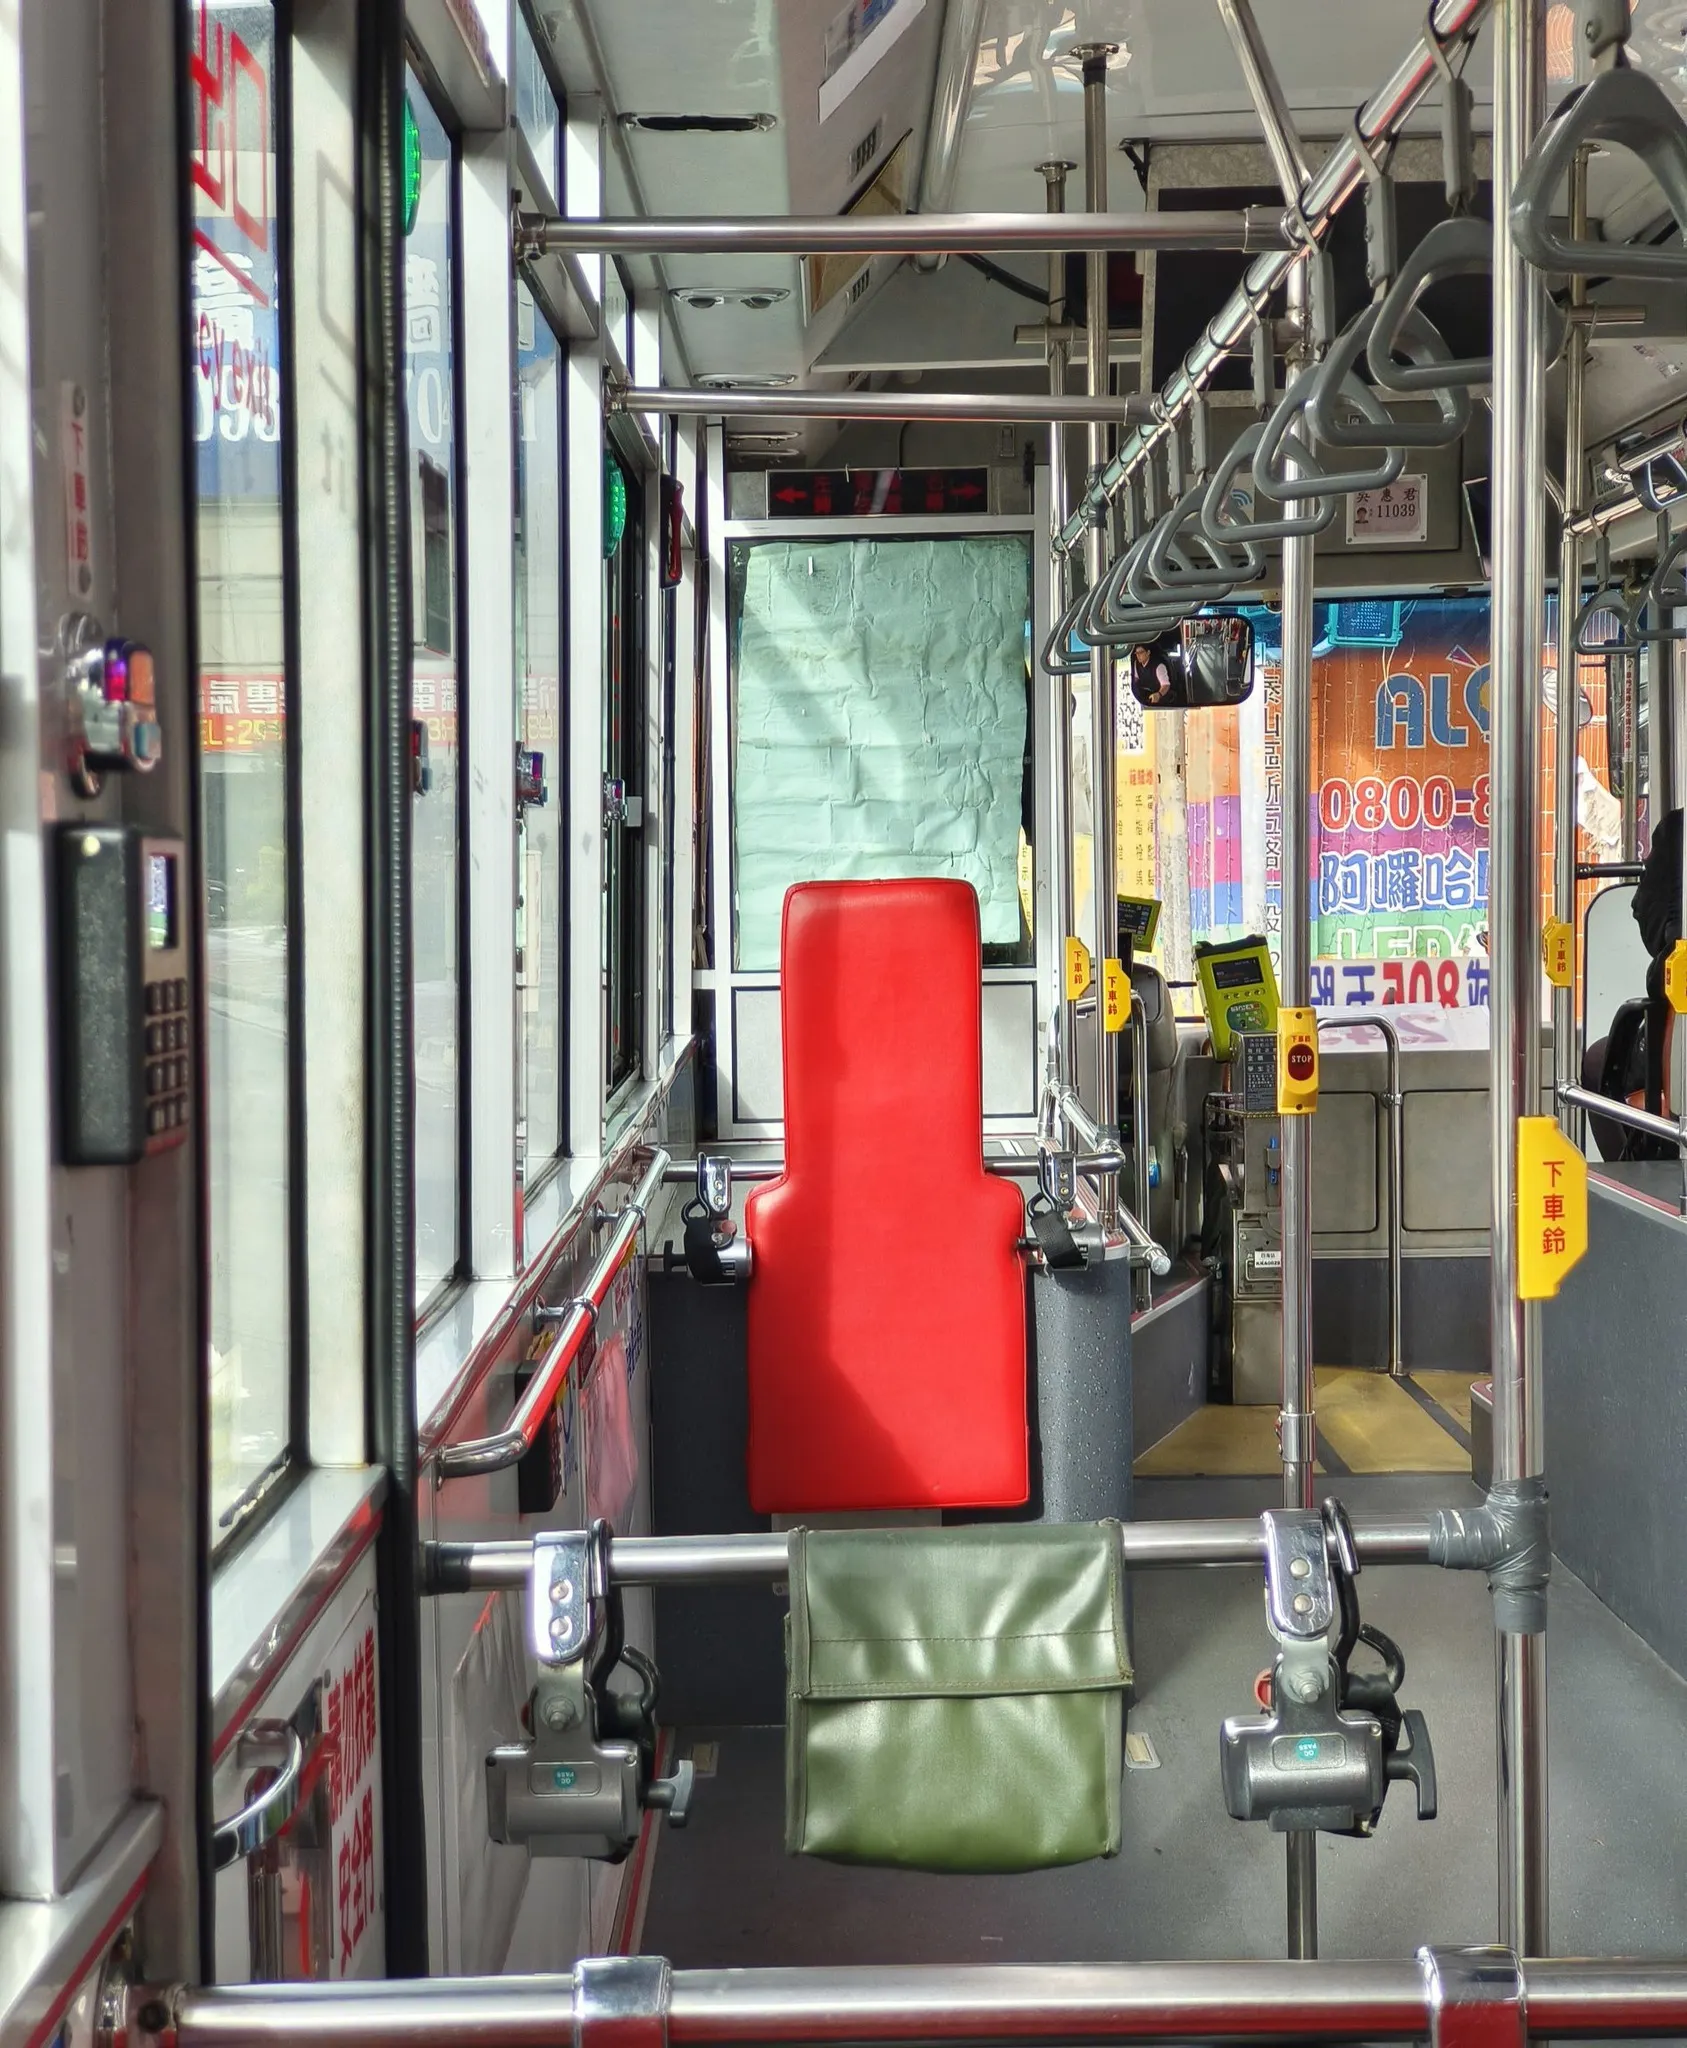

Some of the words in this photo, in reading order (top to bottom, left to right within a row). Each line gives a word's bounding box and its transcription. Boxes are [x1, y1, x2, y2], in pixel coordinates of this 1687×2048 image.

[1377, 503, 1416, 518] 11039
[1108, 976, 1117, 1015] 下車鈴
[1291, 1055, 1312, 1063] STOP
[1542, 1160, 1566, 1255] 下車鈴
